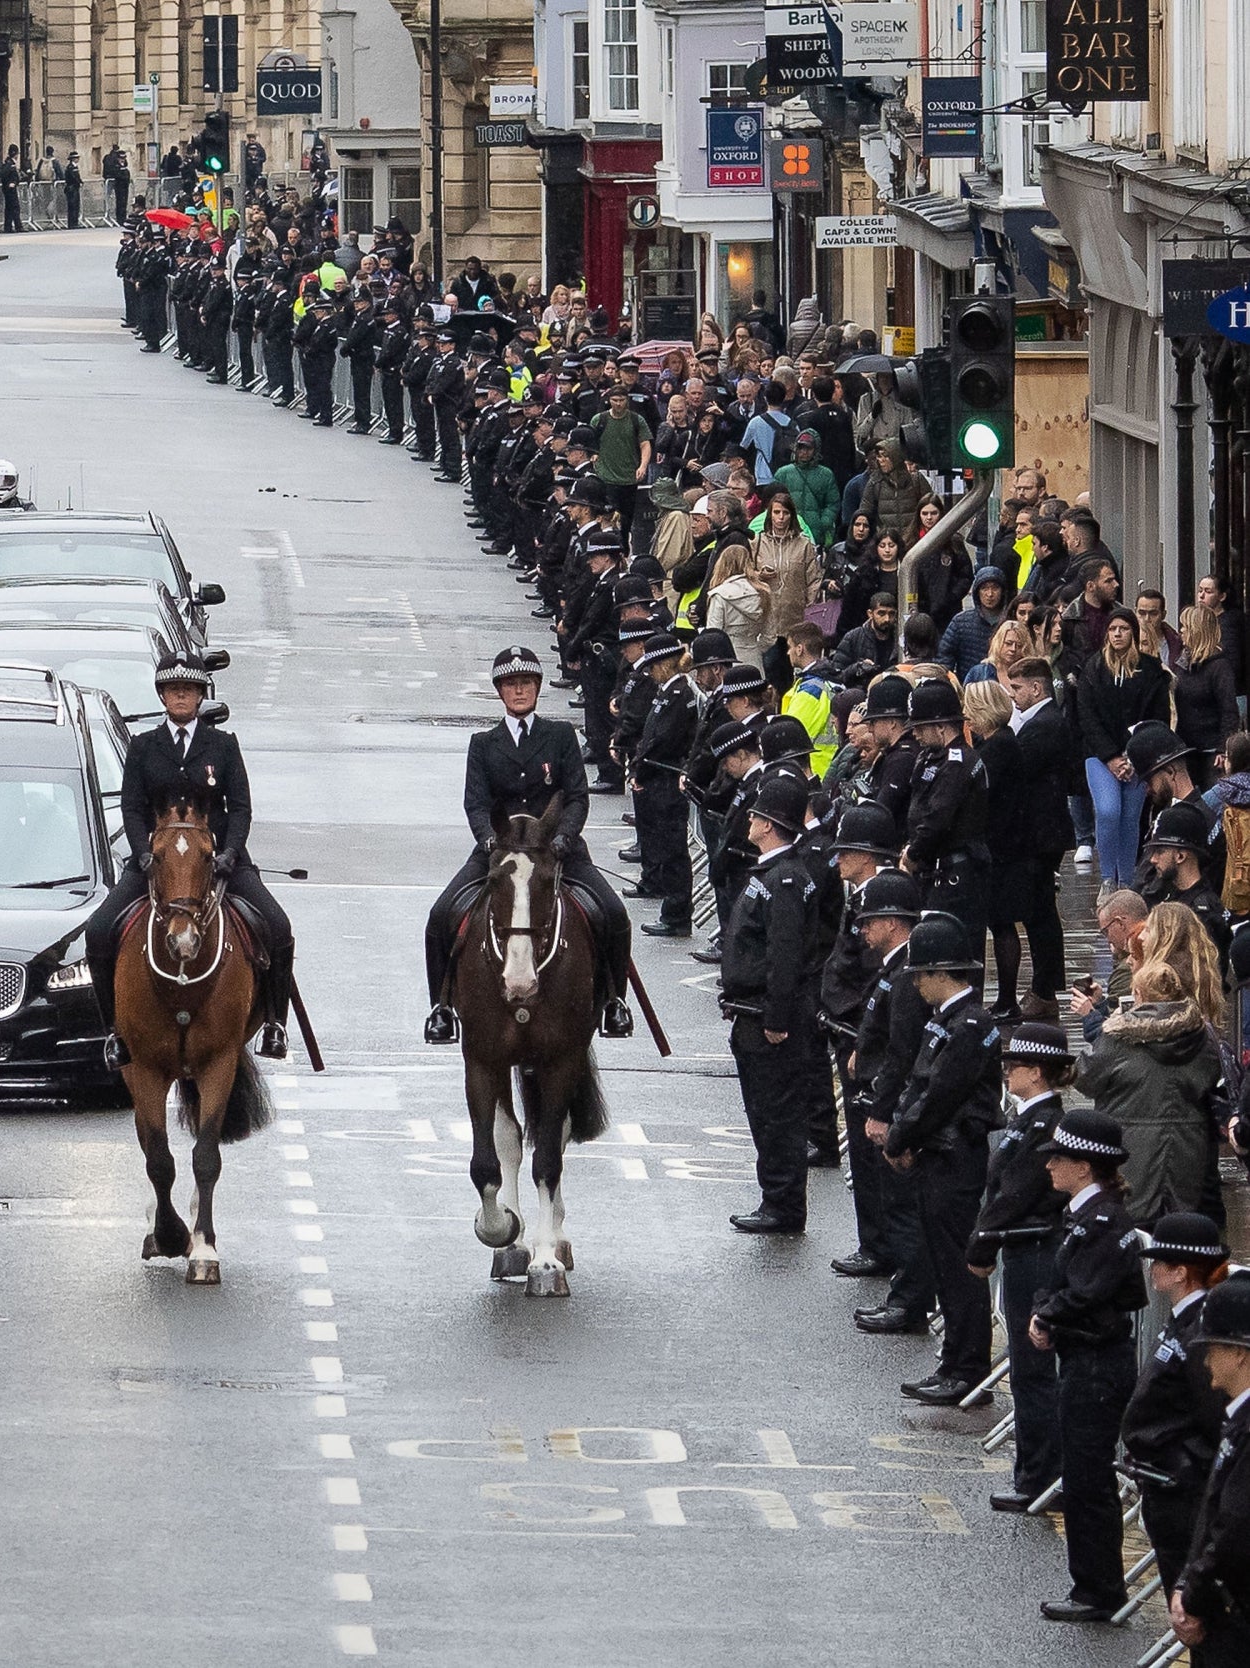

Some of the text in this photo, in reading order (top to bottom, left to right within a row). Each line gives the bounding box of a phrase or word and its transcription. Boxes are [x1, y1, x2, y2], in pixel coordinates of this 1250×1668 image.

[1063, 0, 1134, 26] ALL
[854, 36, 904, 44] APOTHECARY
[1061, 32, 1135, 59] BAR
[817, 53, 830, 64] &
[1057, 65, 1137, 92] ONE
[260, 82, 321, 103] QUOD
[494, 95, 531, 104] BRORA
[927, 101, 976, 111] OXFORD
[475, 124, 524, 143] TOAST
[713, 152, 758, 161] OXFORD
[713, 171, 758, 180] SHOP
[840, 218, 884, 226] COLLEGE
[821, 237, 874, 245] AVAILABLE
